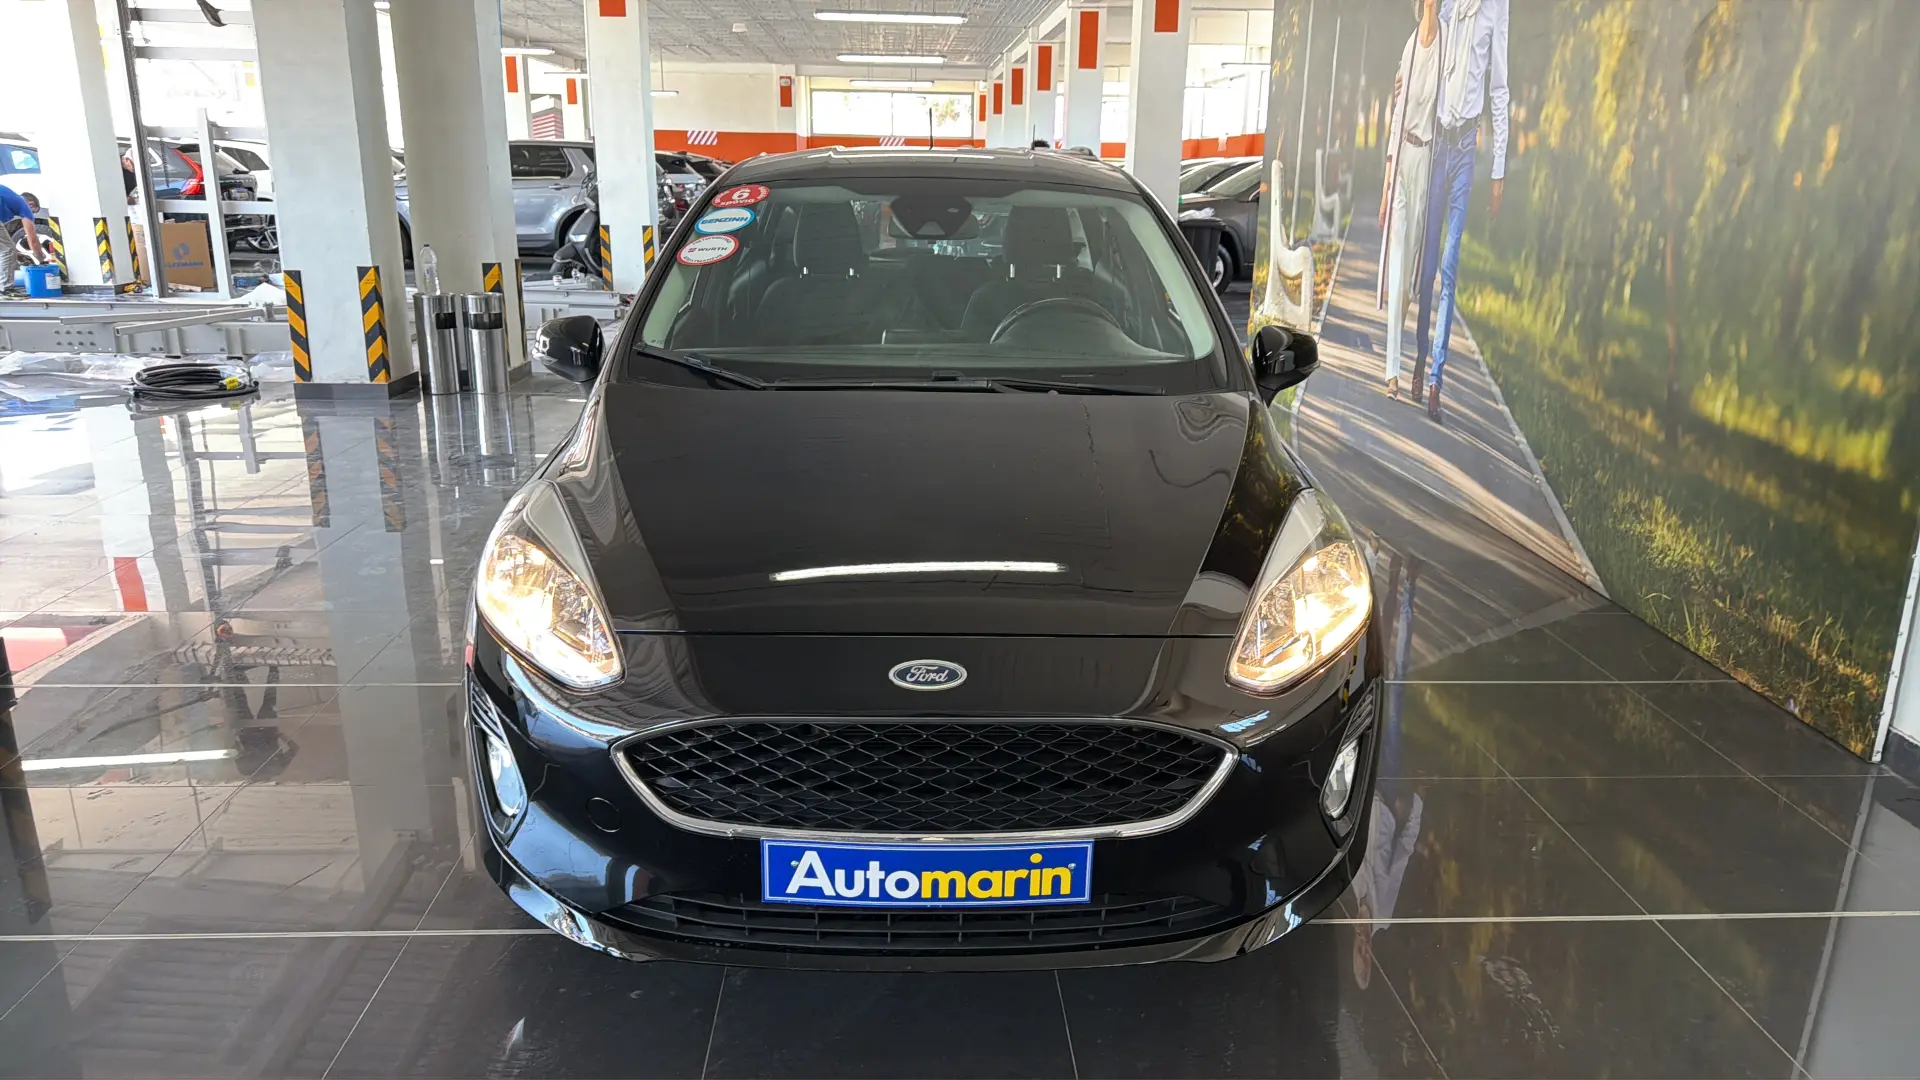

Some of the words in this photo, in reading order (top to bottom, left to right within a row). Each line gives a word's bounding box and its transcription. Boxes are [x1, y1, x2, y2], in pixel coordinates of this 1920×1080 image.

[732, 189, 751, 200] 6
[905, 666, 949, 683] Ford
[785, 850, 1072, 900] Automarin
